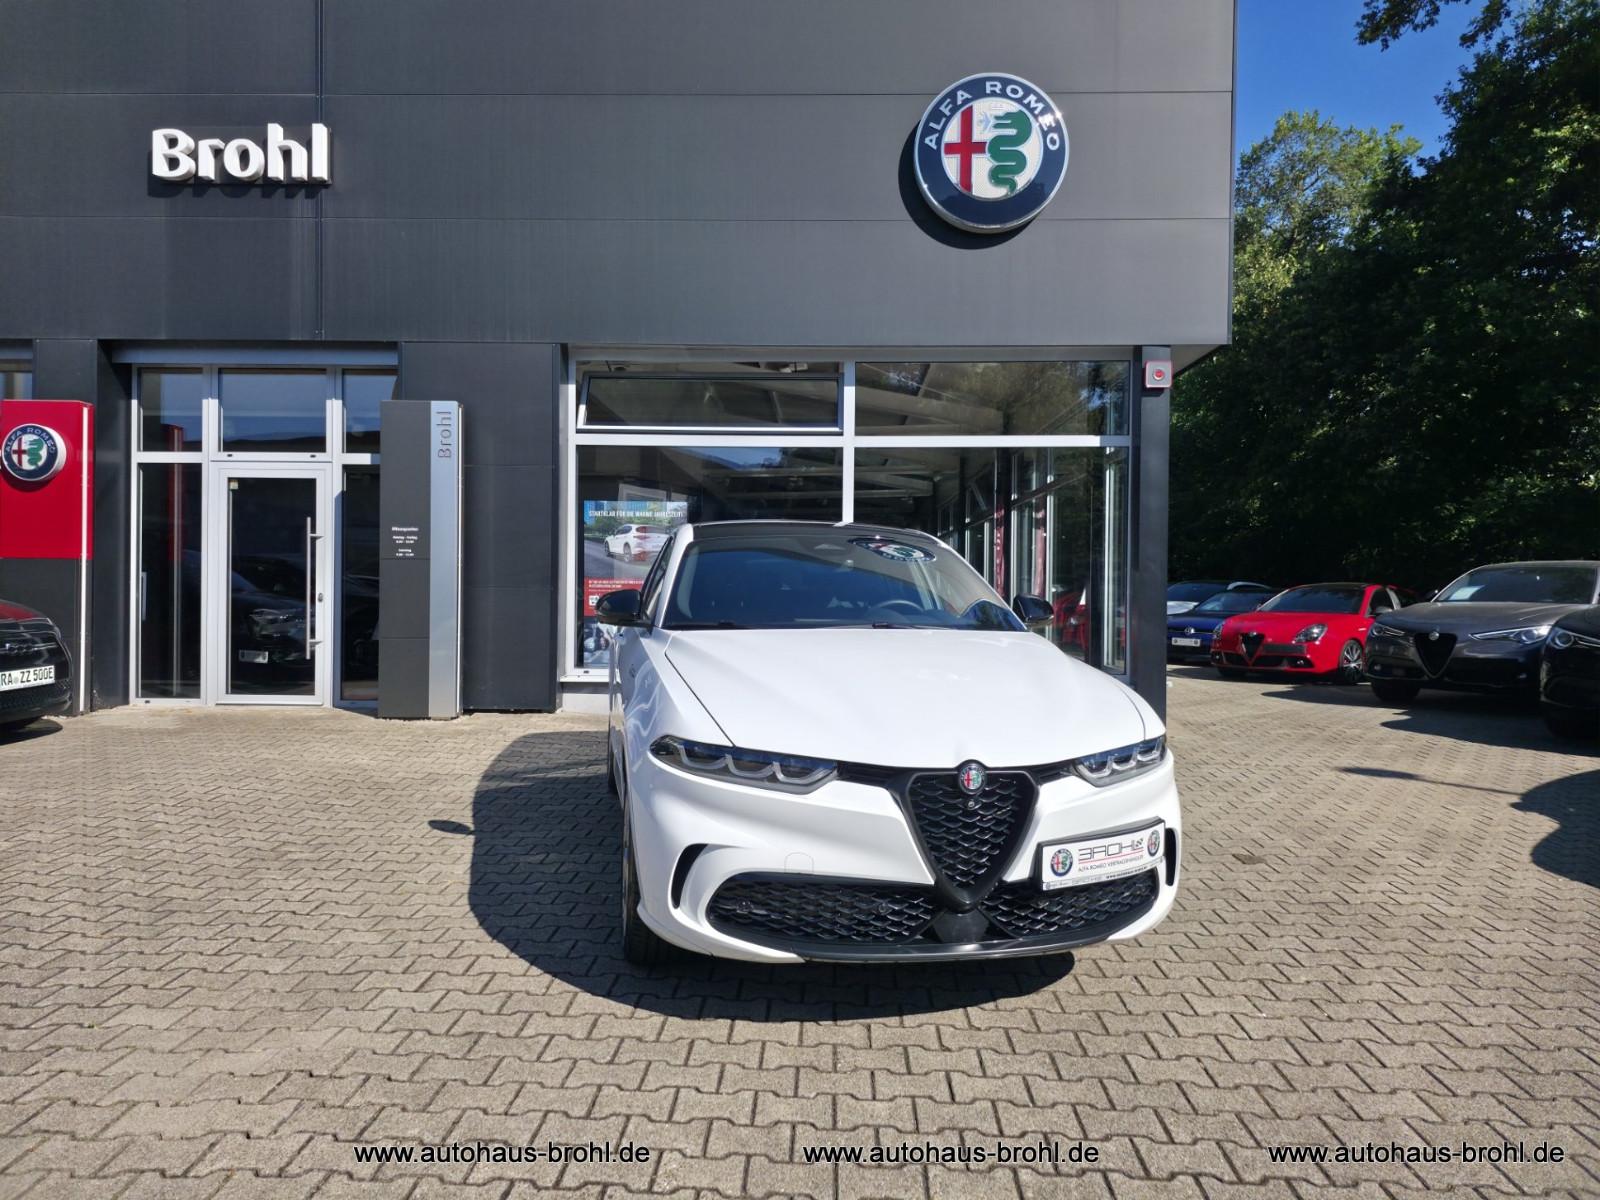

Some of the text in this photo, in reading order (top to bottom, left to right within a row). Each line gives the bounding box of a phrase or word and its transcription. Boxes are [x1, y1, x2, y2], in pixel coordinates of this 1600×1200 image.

[924, 81, 1060, 151] ALFA ROMEO
[152, 123, 328, 181] Brohl
[5, 427, 56, 453] ALFA ROMEO
[436, 411, 452, 458] Brohl
[20, 670, 31, 683] ZZ
